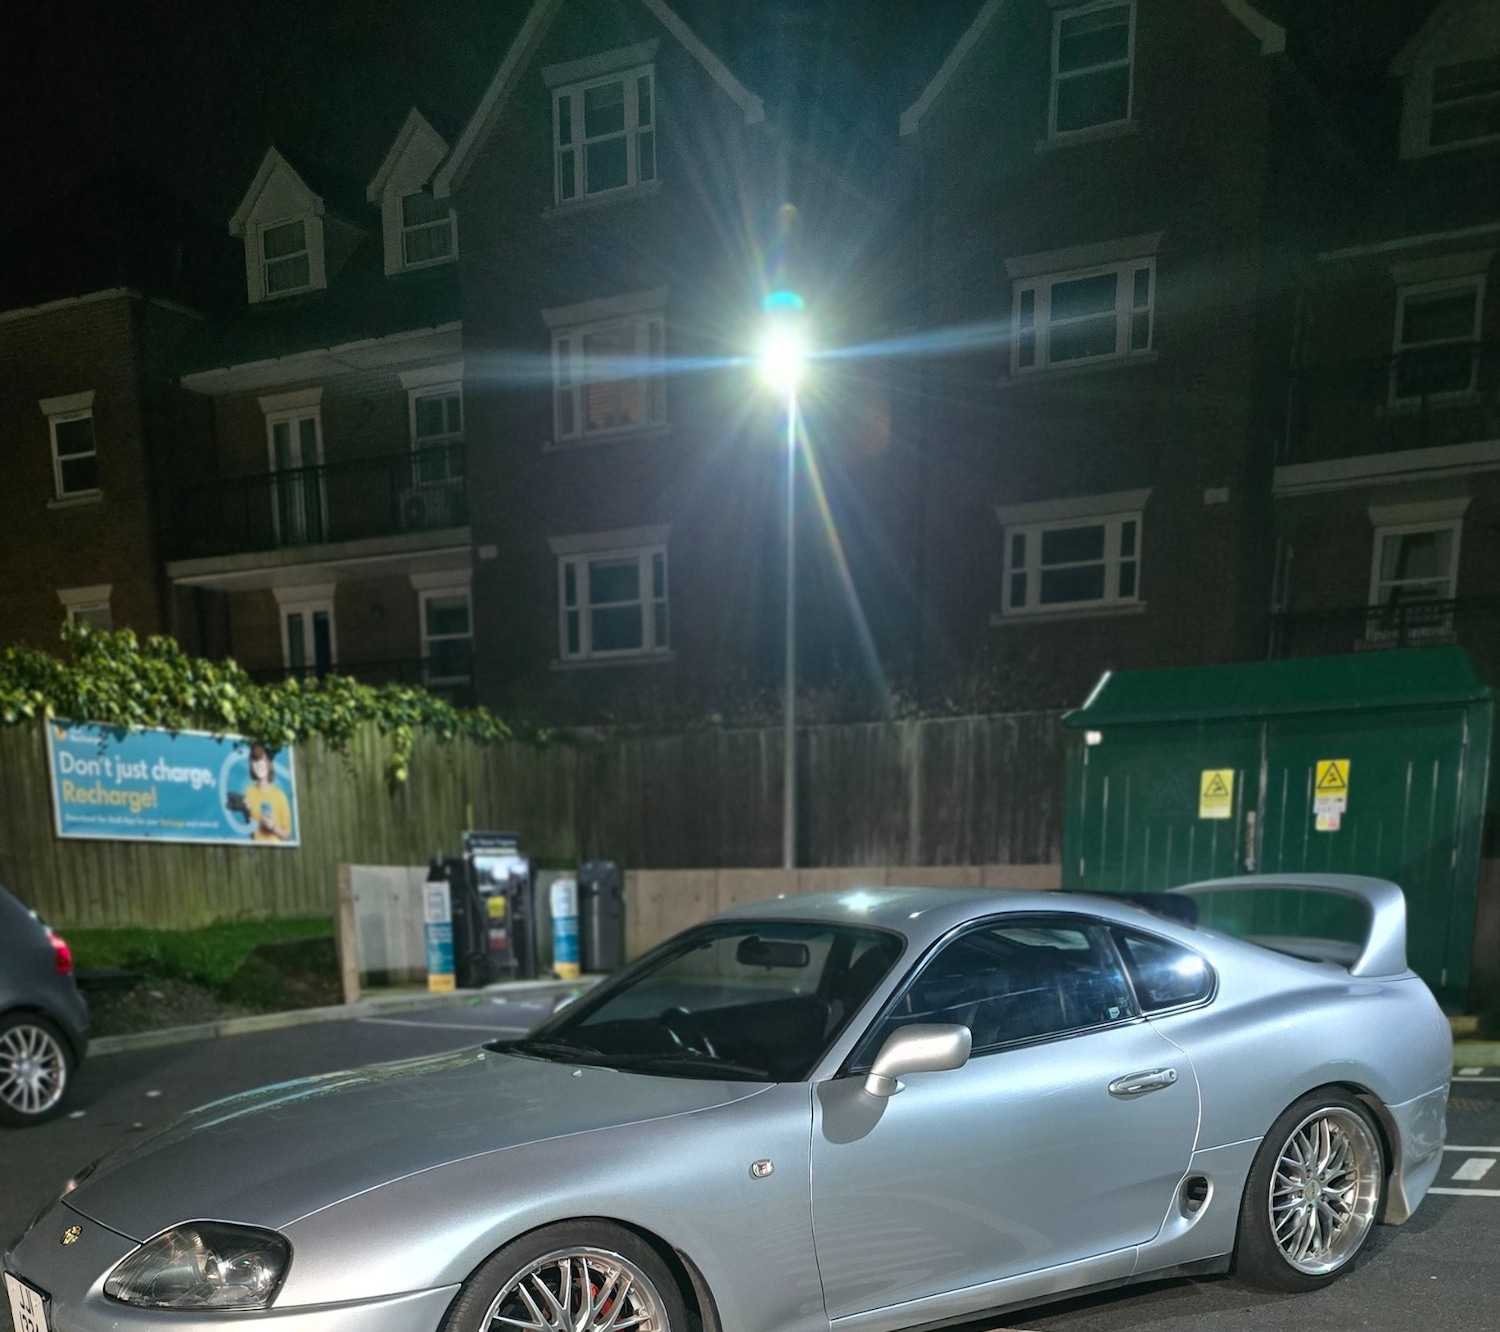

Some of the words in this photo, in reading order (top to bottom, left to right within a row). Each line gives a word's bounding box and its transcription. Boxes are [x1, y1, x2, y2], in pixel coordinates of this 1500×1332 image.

[59, 751, 113, 777] Don't
[115, 755, 148, 785] just
[152, 757, 216, 790] charge,
[62, 780, 157, 813] Recharge!
